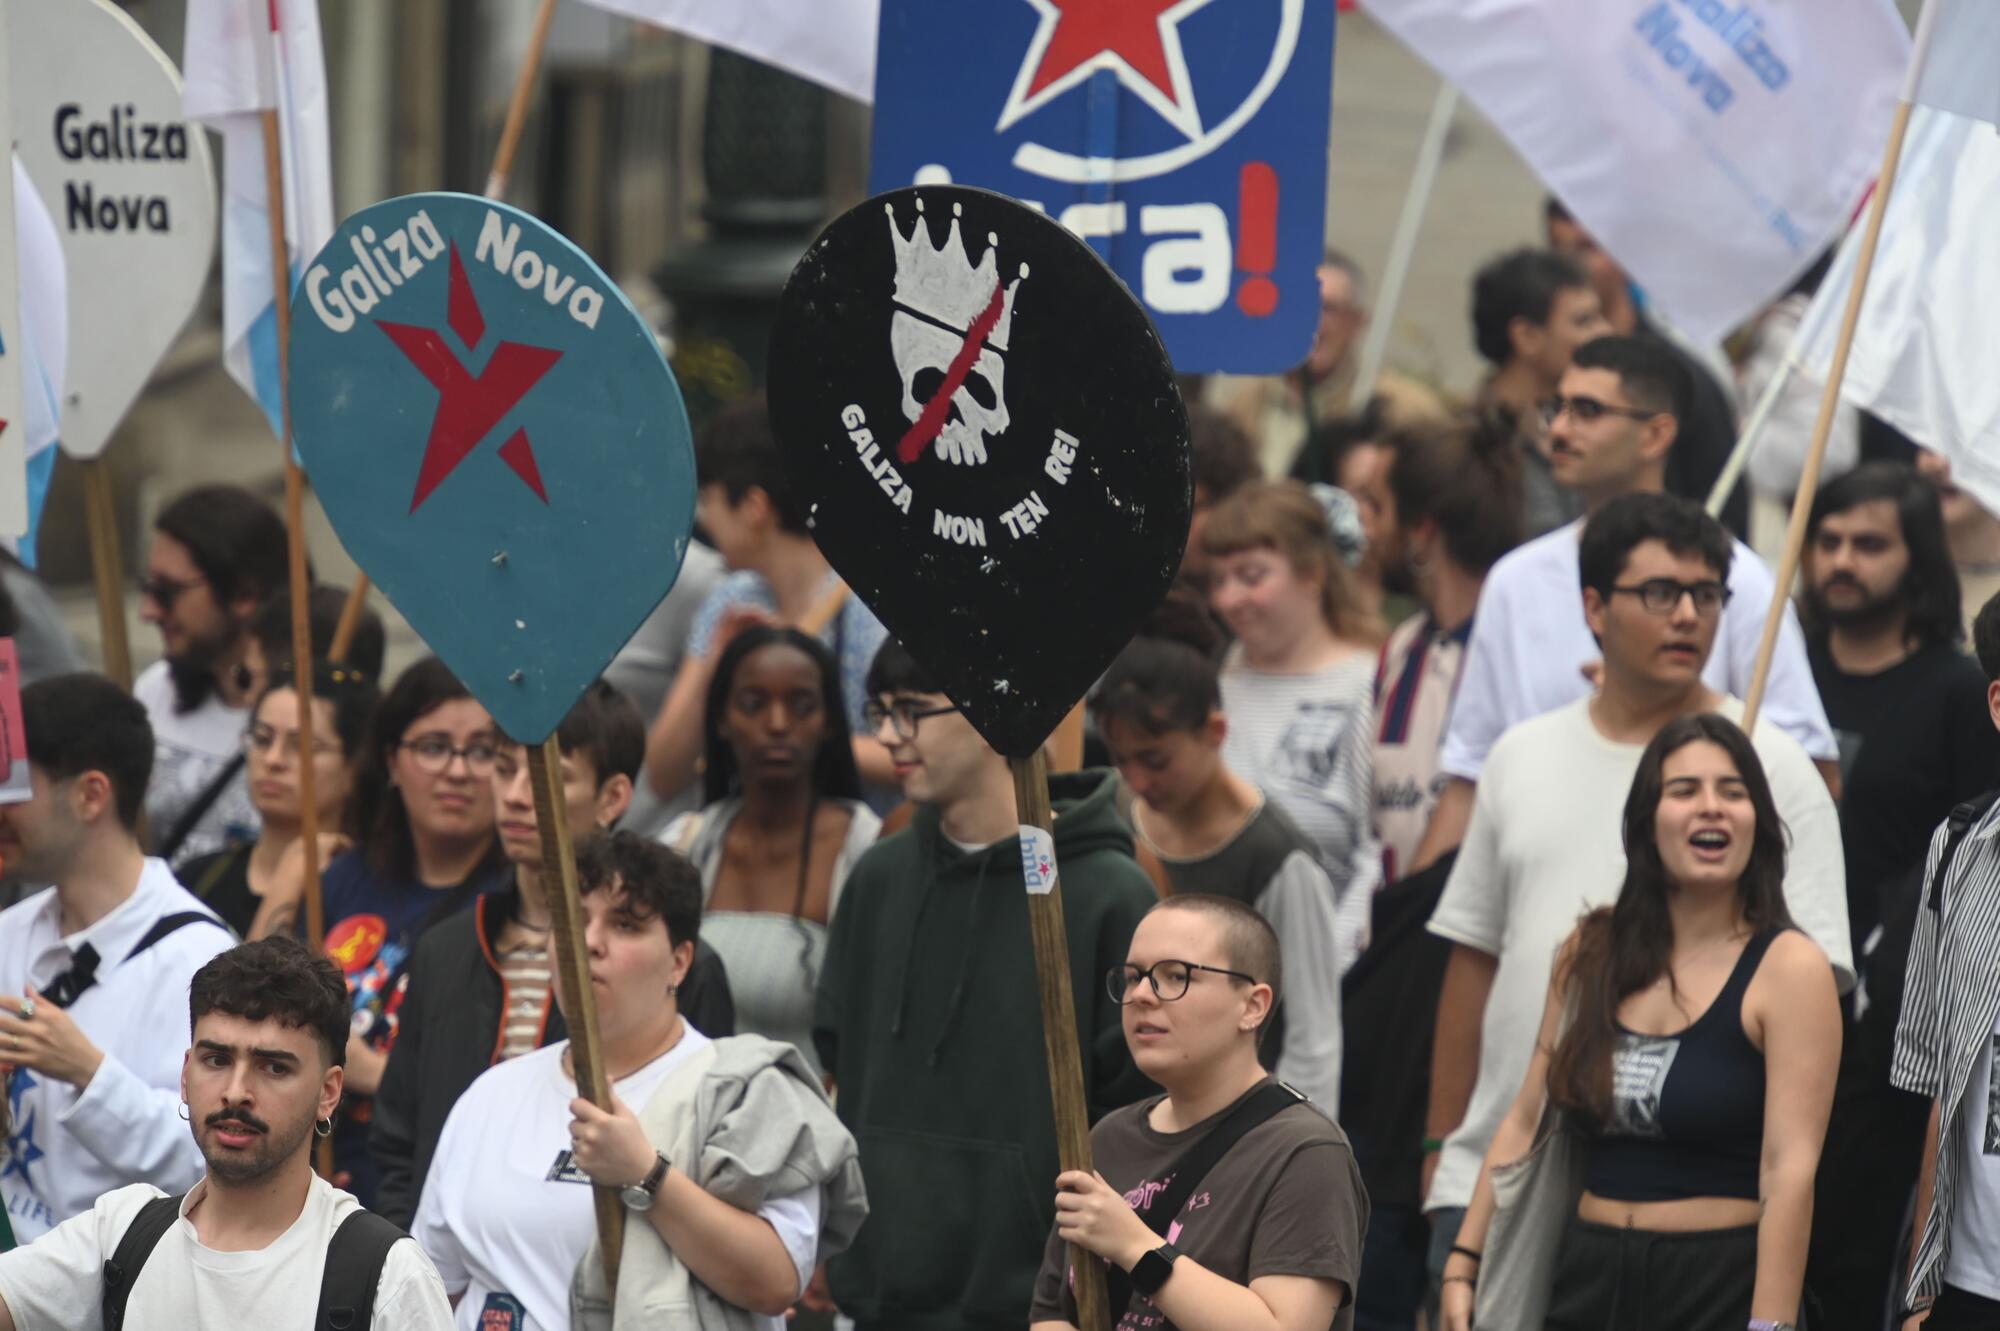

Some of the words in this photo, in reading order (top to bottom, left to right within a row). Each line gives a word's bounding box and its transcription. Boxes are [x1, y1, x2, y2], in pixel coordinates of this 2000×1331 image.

[1634, 1, 1735, 114] Nova
[1679, 0, 1790, 92] aliza
[54, 103, 188, 161] Galiza
[65, 181, 170, 232] Nova
[305, 209, 446, 332] Galiza
[475, 208, 604, 330] Nova
[841, 403, 913, 514] GALIZA
[933, 508, 987, 547] NON
[1000, 490, 1049, 540] TEN
[1044, 428, 1080, 485] REI
